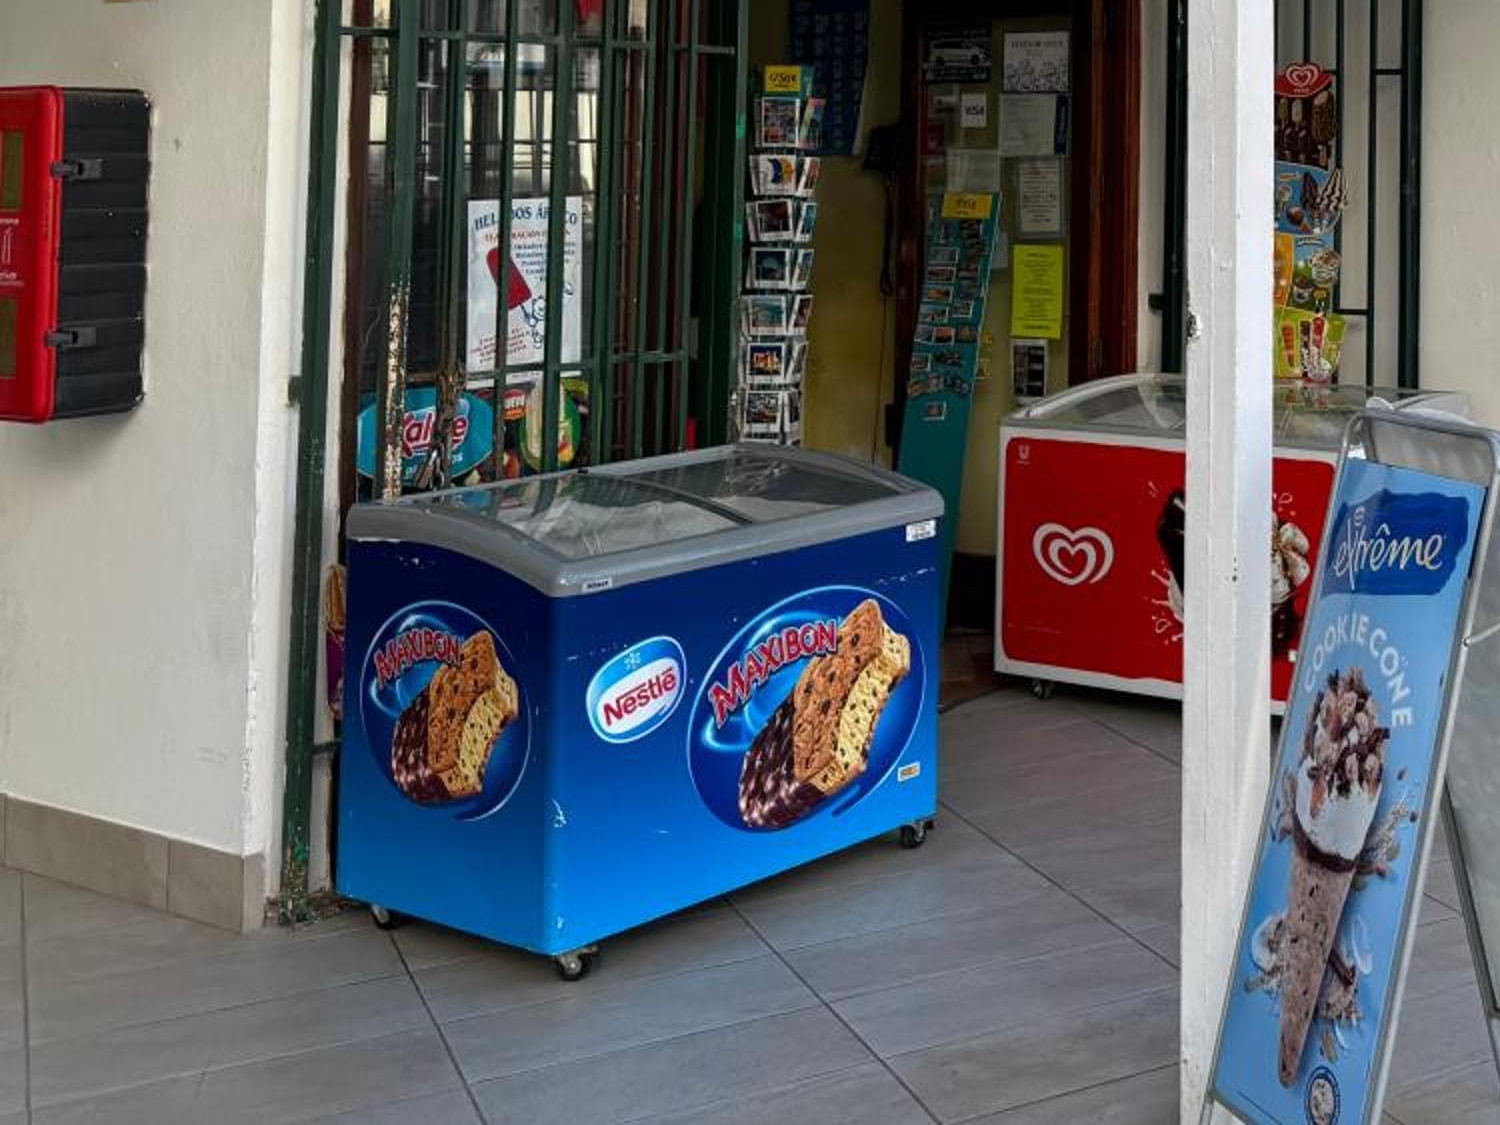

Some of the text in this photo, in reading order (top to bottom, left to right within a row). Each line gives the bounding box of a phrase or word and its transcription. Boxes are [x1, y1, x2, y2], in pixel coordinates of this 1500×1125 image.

[474, 206, 532, 232] HELDOS
[373, 626, 467, 688] MAXIBON
[708, 618, 839, 728] MAXIBON
[1304, 612, 1413, 727] COOKIE CONE
[602, 667, 678, 727] Nestlé
